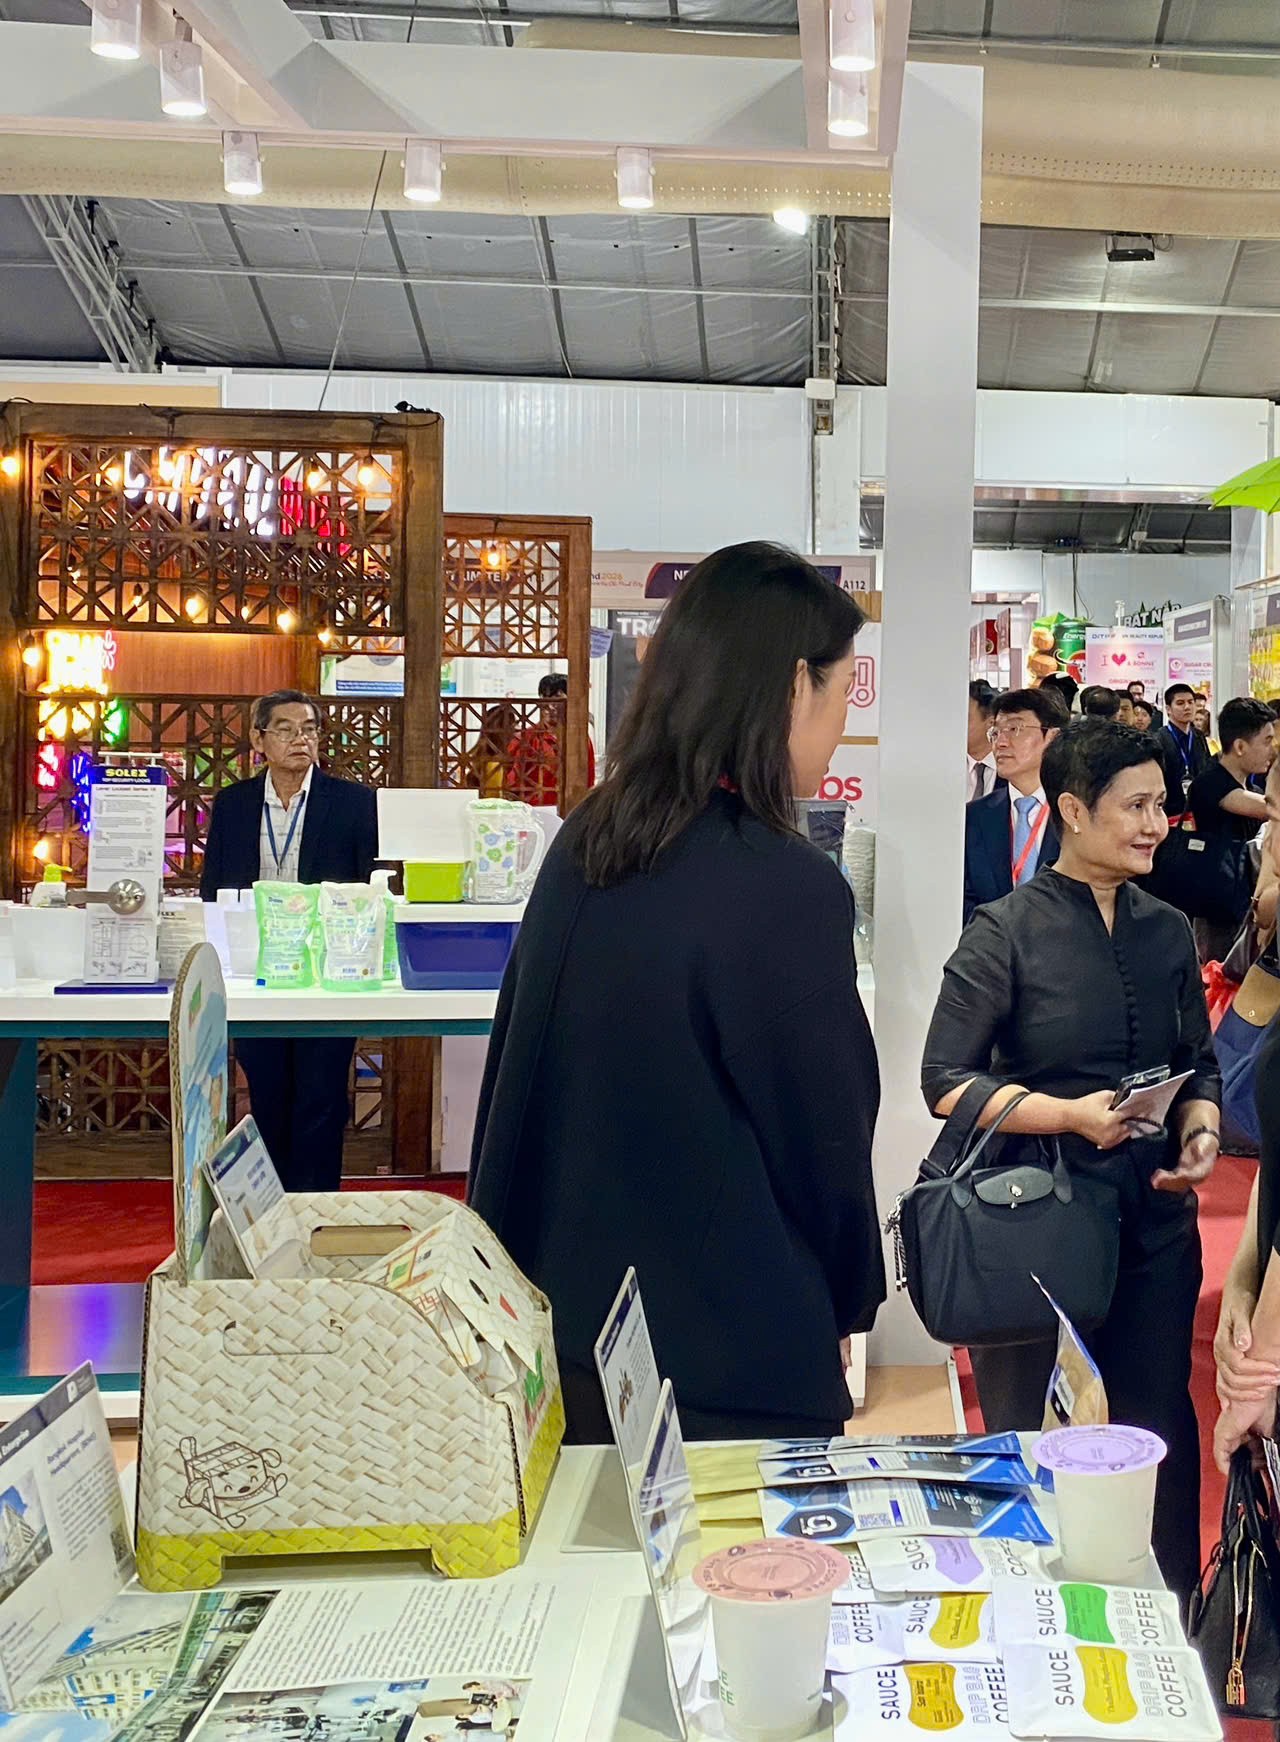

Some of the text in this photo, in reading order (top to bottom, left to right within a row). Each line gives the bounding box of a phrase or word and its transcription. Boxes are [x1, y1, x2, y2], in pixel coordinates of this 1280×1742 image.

[463, 571, 510, 582] LIMTED
[843, 581, 866, 591] A112
[105, 769, 147, 778] SOLEX
[1034, 1588, 1057, 1636] SAUCE
[877, 1669, 901, 1720] SAUCE
[984, 1666, 1009, 1724] COFFEE
[1049, 1650, 1074, 1706] SAUCE
[1155, 1654, 1188, 1718] COFFEE
